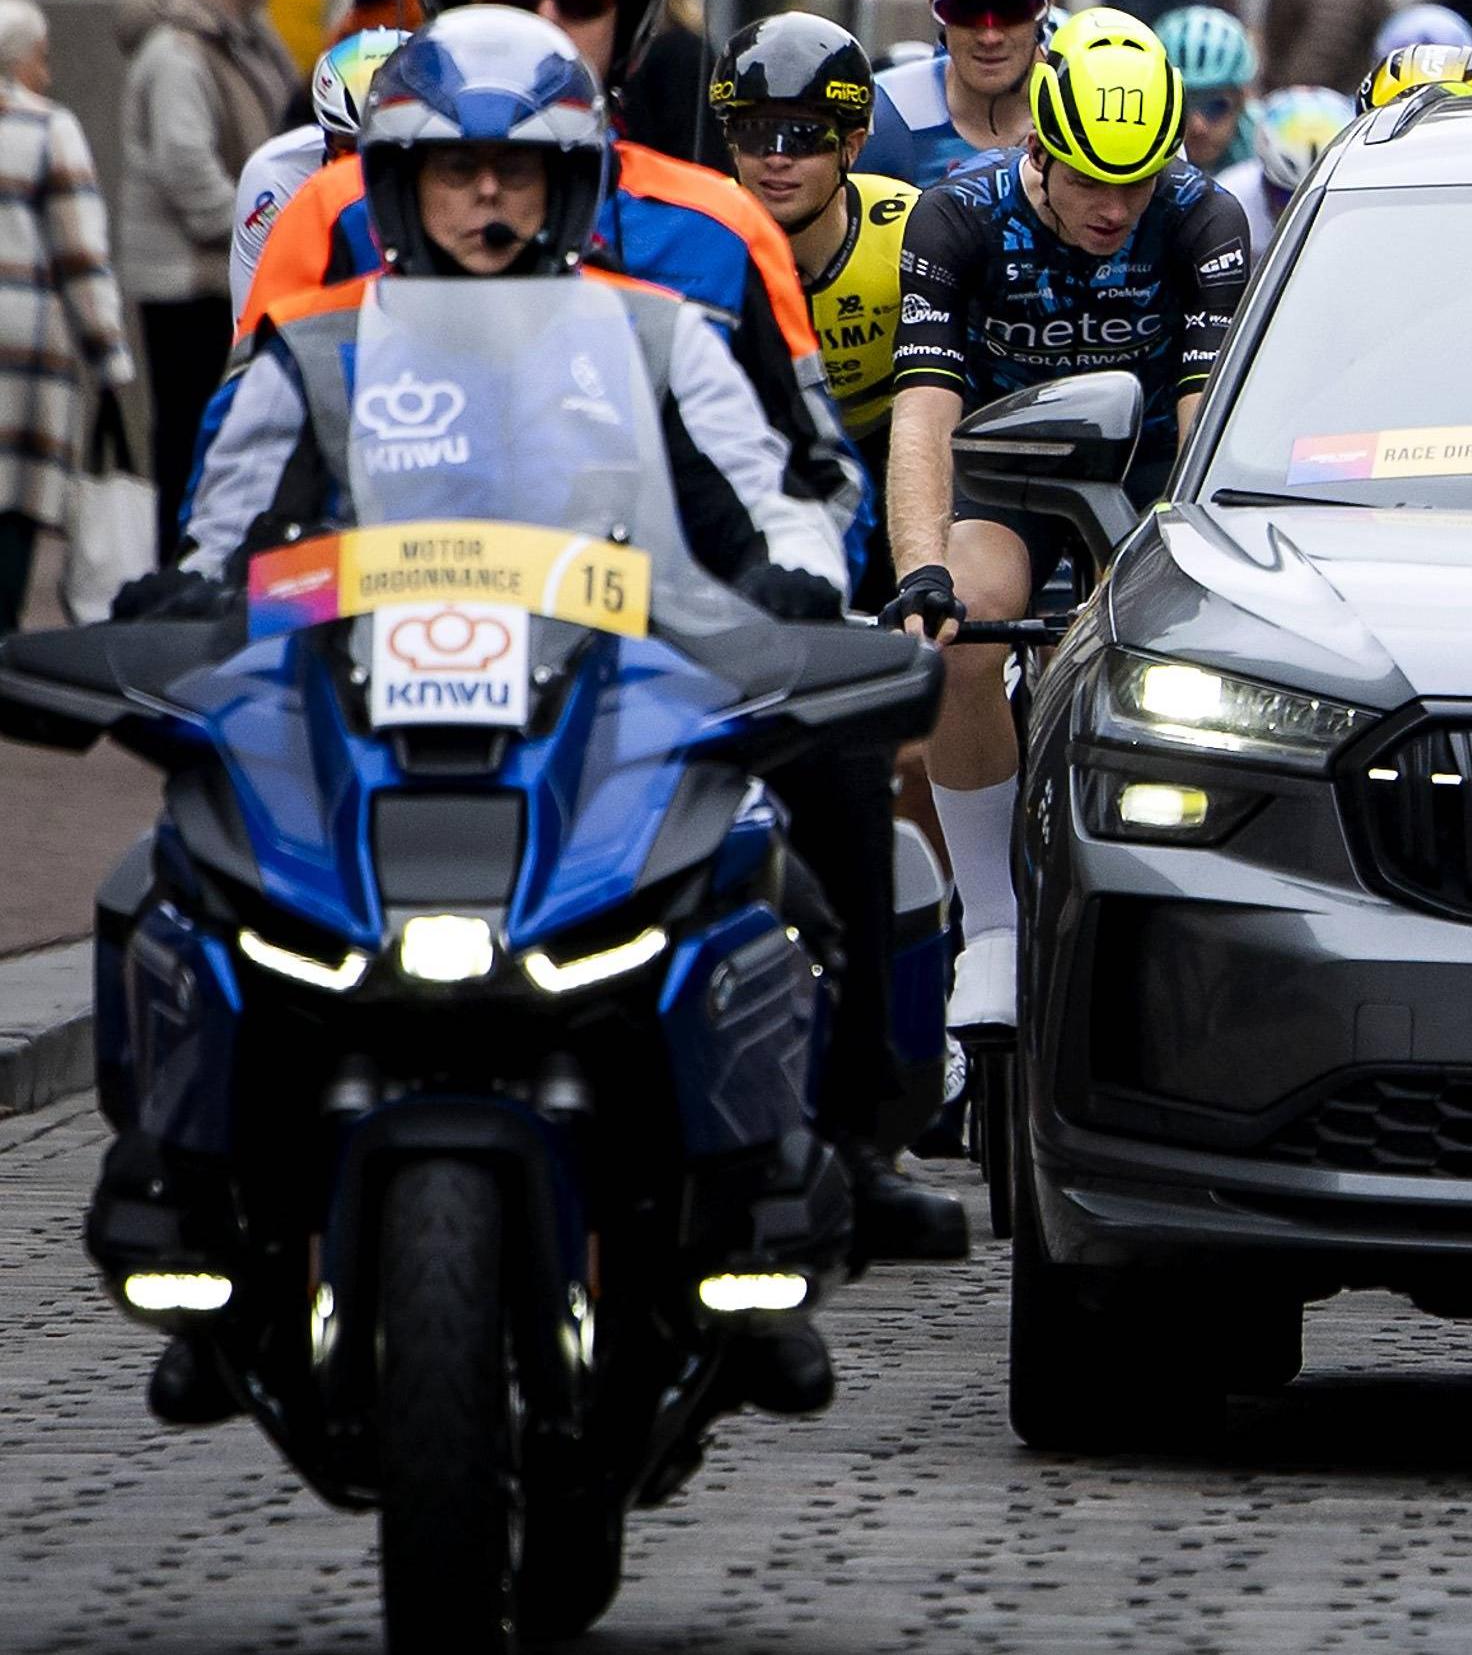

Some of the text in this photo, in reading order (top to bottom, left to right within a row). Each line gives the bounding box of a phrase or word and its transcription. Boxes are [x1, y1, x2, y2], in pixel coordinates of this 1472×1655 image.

[826, 80, 870, 104] GIRO
[1200, 249, 1244, 274] GPS
[984, 313, 1161, 348] metec
[1384, 444, 1434, 461] RACE
[402, 541, 484, 561] MOTOR
[361, 567, 523, 596] ORDONNANCE
[582, 563, 625, 613] 15
